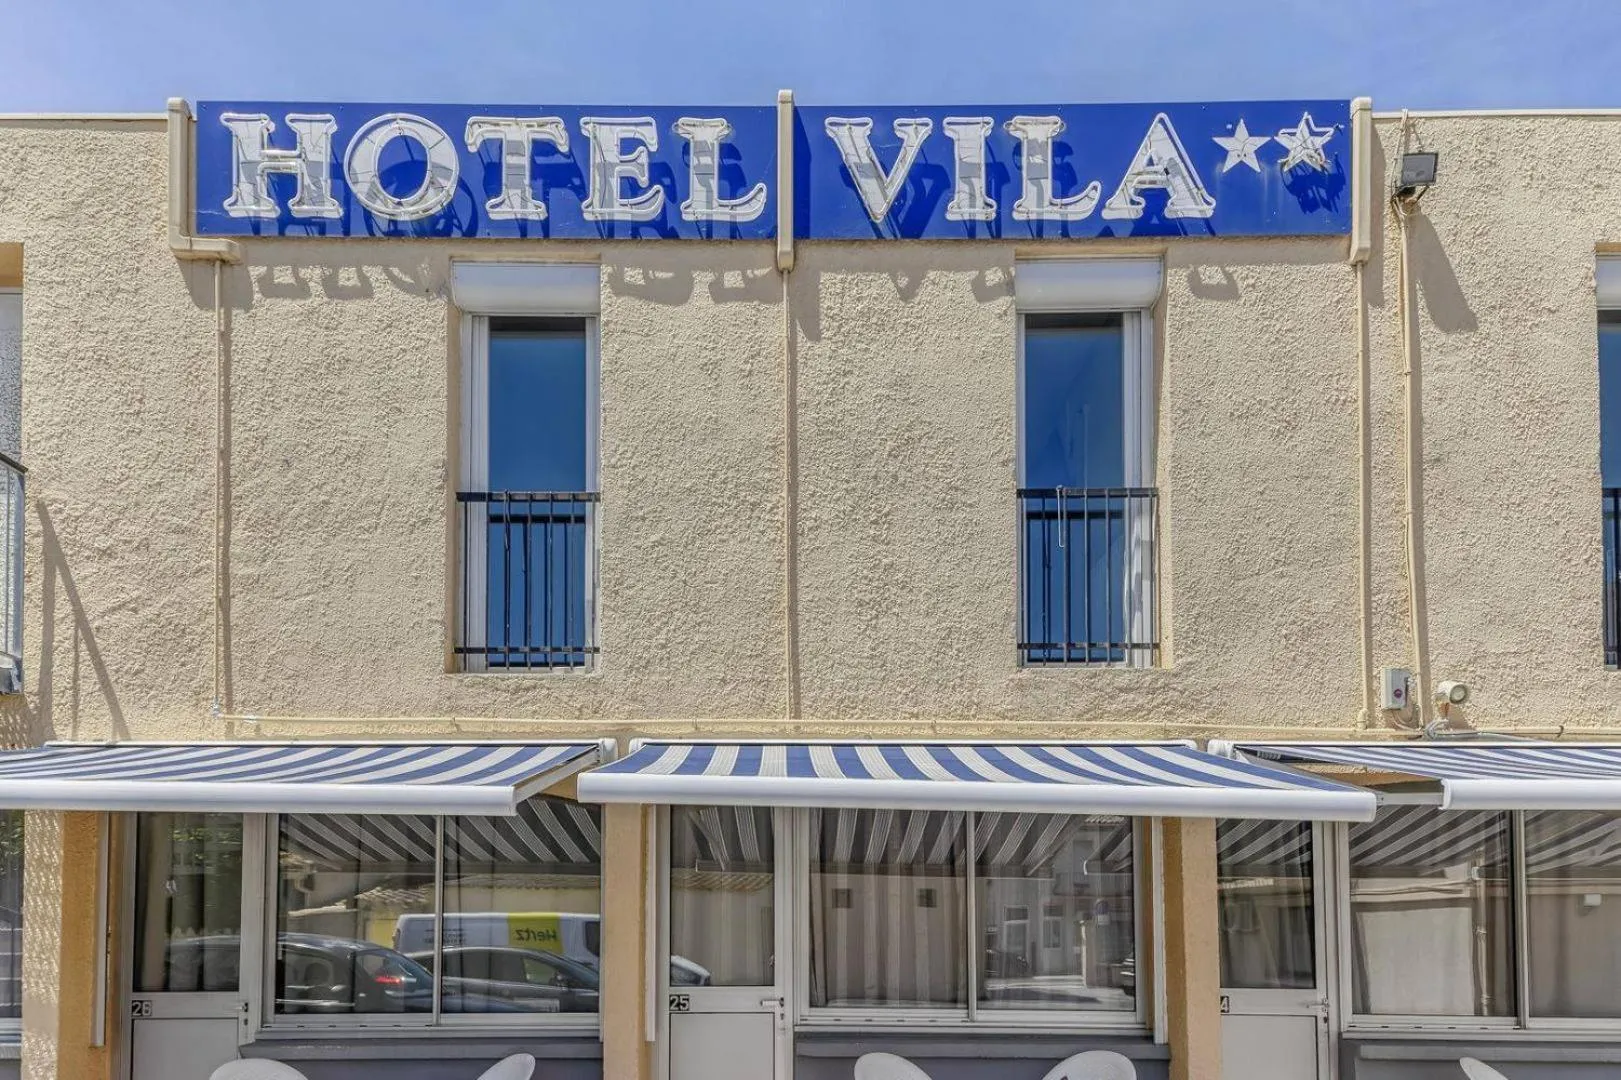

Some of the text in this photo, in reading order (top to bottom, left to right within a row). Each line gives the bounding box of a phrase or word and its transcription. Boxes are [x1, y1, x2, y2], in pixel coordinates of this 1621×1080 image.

[219, 111, 1217, 223] HOTEL VILA
[669, 996, 689, 1011] 25
